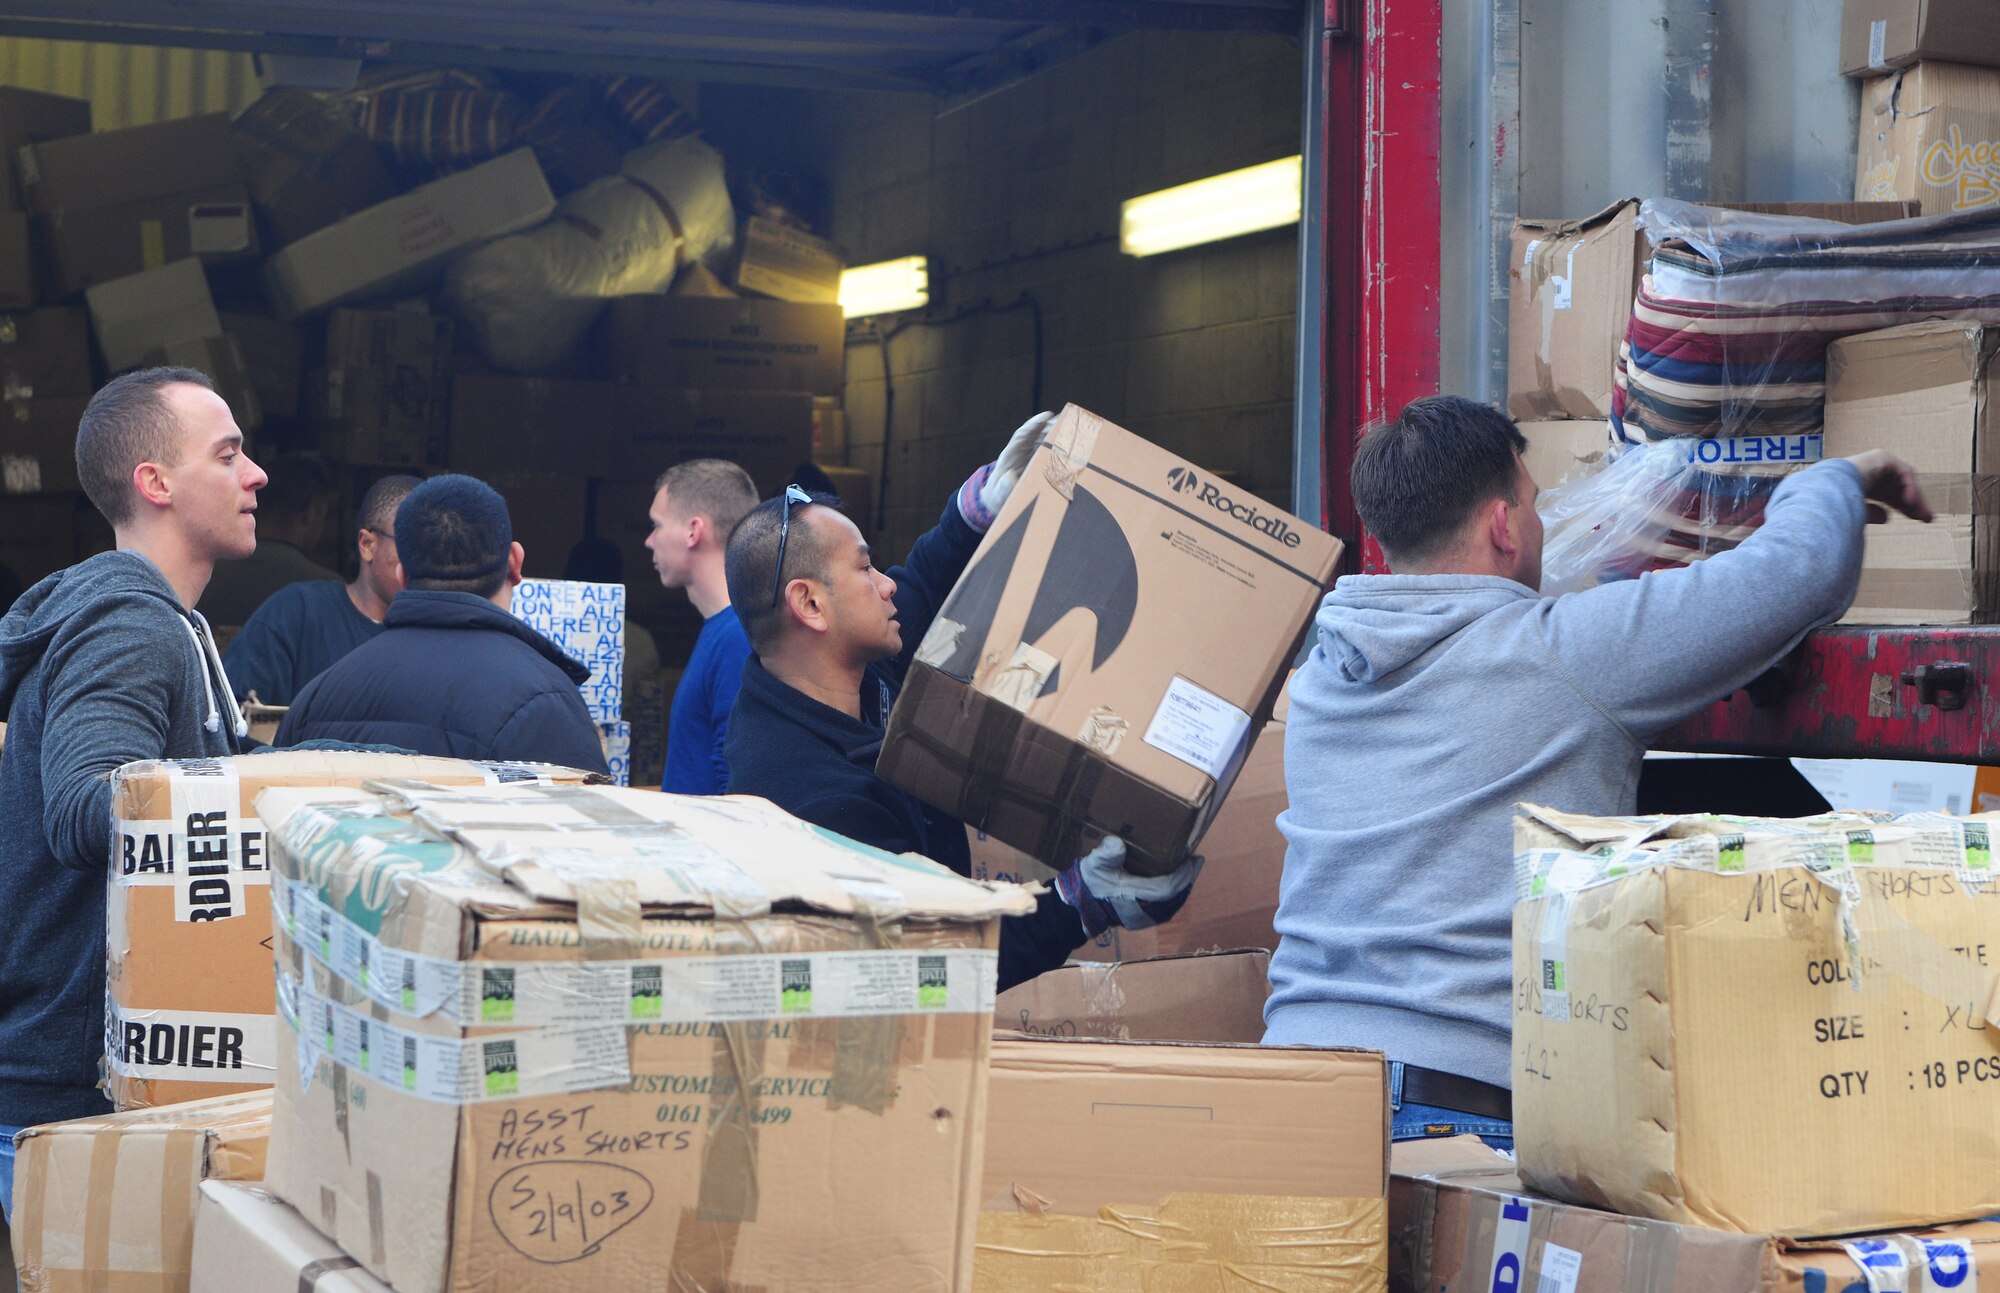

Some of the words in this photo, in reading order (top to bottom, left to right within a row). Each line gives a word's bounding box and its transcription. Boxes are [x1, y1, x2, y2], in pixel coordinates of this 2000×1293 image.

[1196, 481, 1302, 548] Rocialle
[1814, 1014, 1865, 1043] SIZE
[1820, 1070, 1869, 1099] QTY
[1922, 1061, 1947, 1089] 18
[1957, 1055, 2000, 1085] PCS
[500, 1104, 595, 1139] ASST
[656, 1104, 703, 1124] 0161
[493, 1135, 567, 1160] MENS
[585, 1130, 692, 1156] SHORTS
